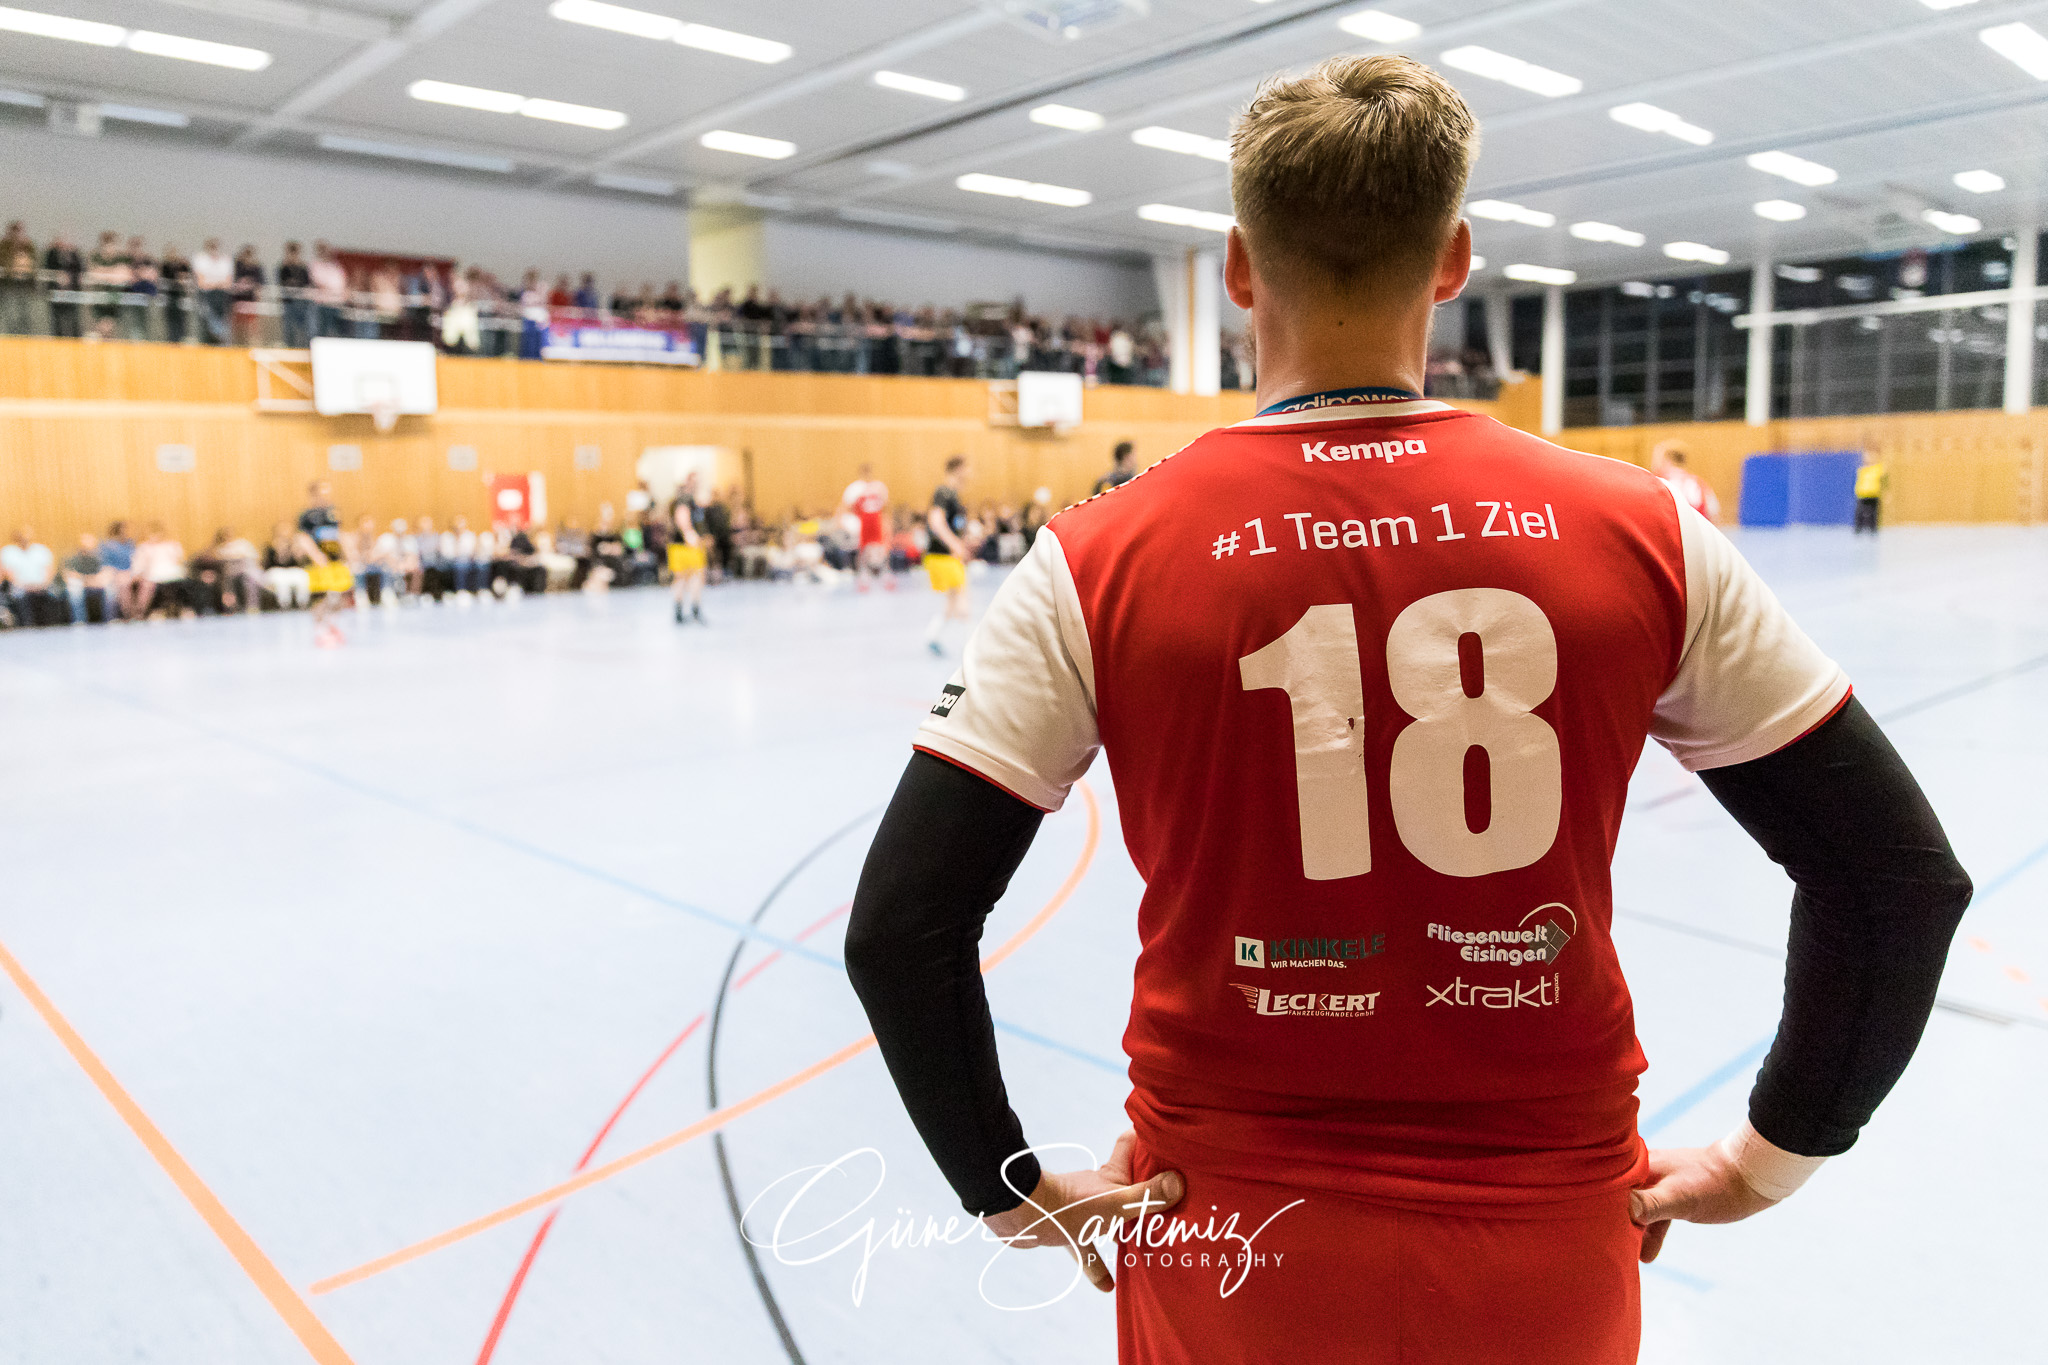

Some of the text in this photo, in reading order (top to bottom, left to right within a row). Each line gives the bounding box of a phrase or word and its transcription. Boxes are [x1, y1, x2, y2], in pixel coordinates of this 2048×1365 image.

[1301, 437, 1427, 463] Kempa
[1211, 501, 1560, 560] #1 Team 1 Ziel
[1238, 587, 1562, 881] 18
[1427, 922, 1548, 944] Fliesenwelt
[1241, 933, 1385, 962] K KINKELE
[1460, 944, 1547, 966] Eisingen
[1271, 959, 1347, 969] WIR MACHEN DAS.
[1425, 976, 1552, 1009] xtrakt
[1288, 1009, 1353, 1018] FAHRZEUGHANDEL
